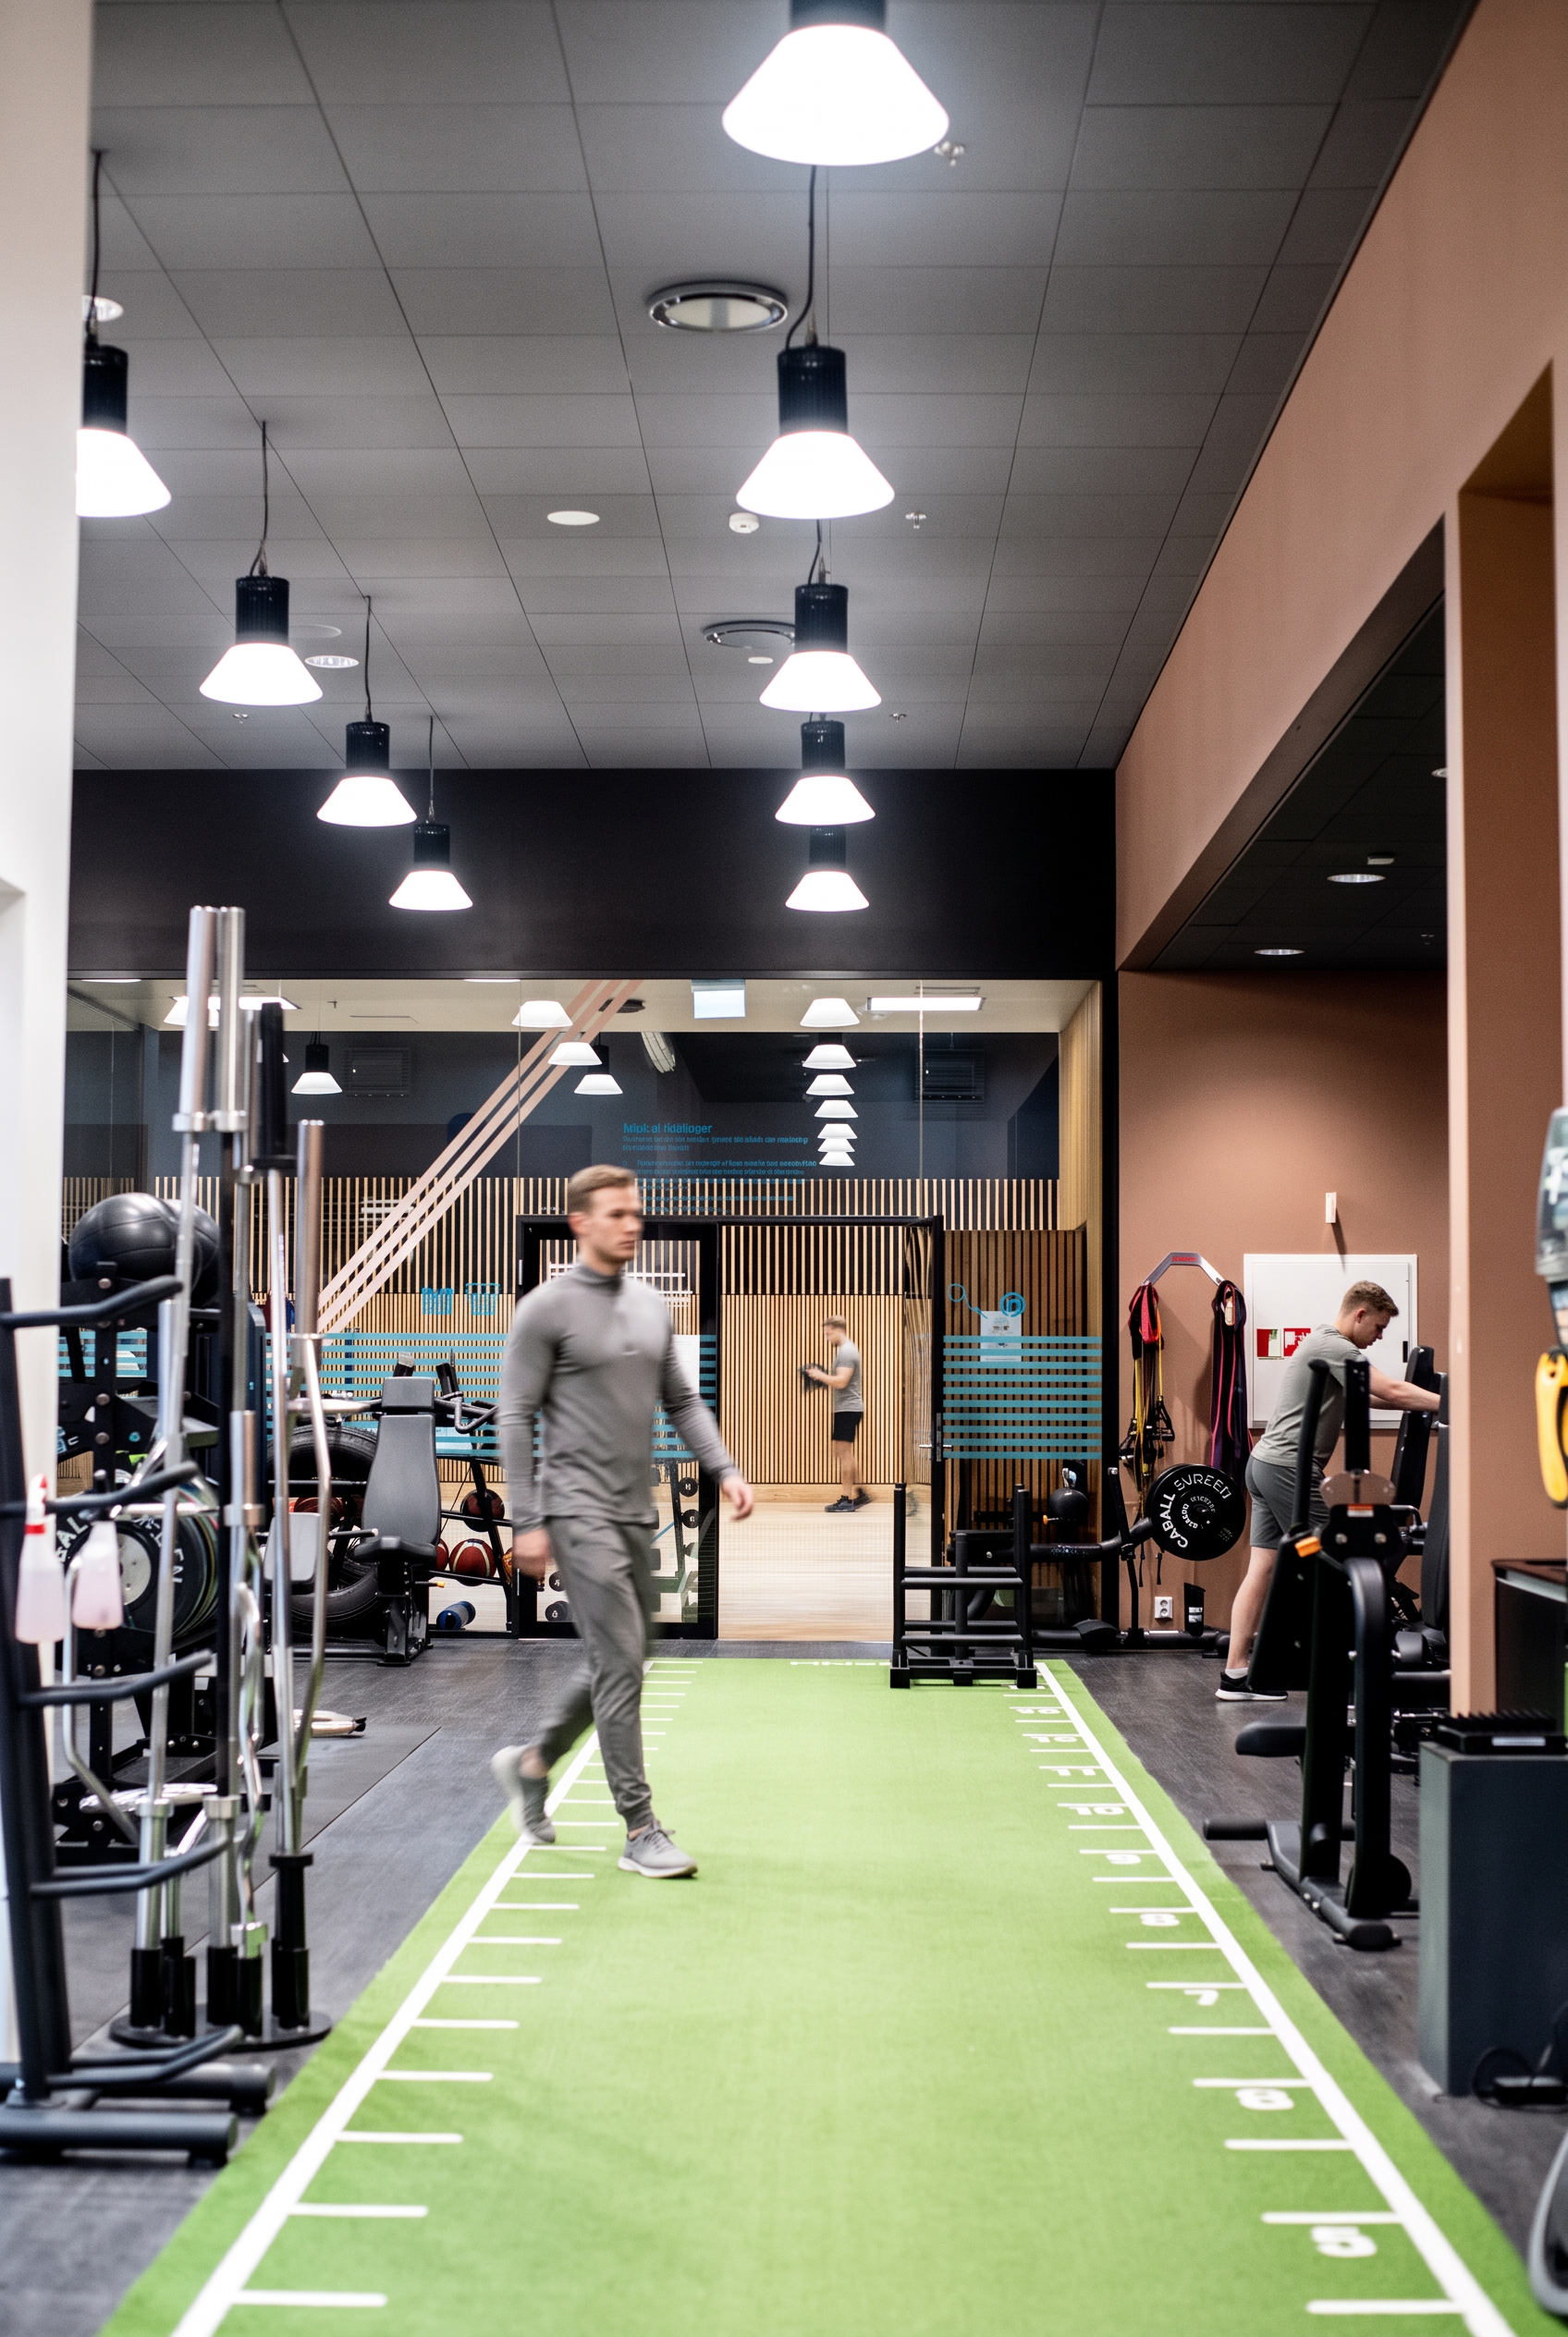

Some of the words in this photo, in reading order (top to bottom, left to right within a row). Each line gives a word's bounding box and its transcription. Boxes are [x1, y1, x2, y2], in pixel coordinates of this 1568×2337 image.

[1069, 1806, 1124, 1816] 10
[1106, 1853, 1141, 1866] 9
[1183, 1989, 1219, 2005] 7
[1310, 2225, 1378, 2258] 5
